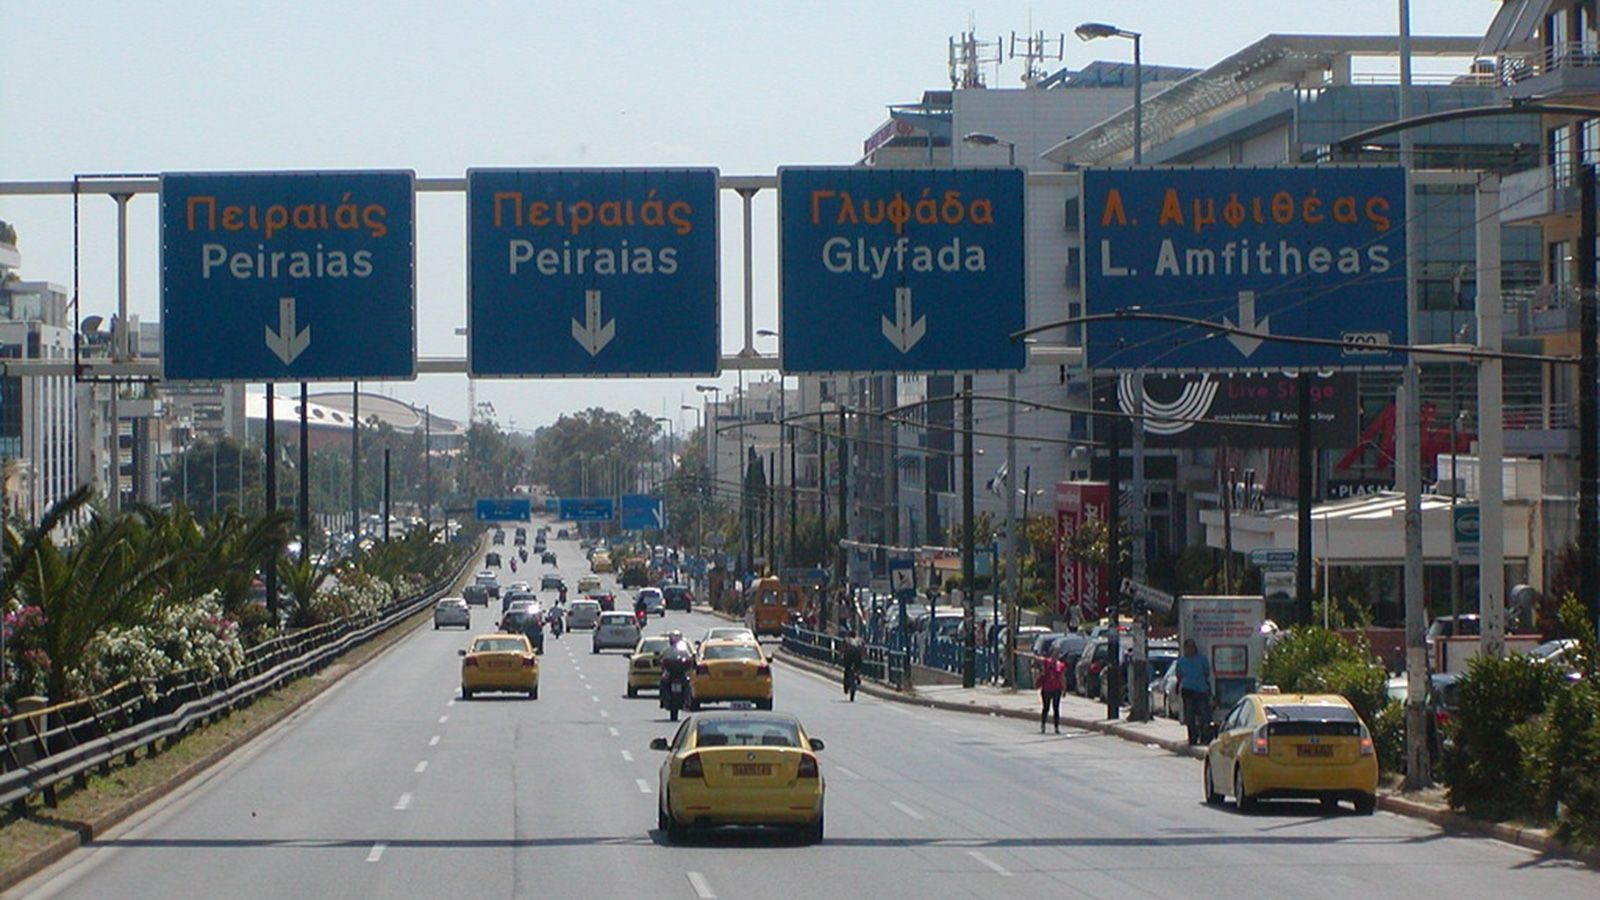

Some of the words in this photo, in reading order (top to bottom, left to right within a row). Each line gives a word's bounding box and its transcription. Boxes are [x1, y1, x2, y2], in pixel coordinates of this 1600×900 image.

[187, 192, 388, 240] Πειραιάς
[493, 189, 693, 235] Πειραιάς
[811, 188, 994, 235] Γλυφάδα
[1100, 189, 1138, 226] Λ.
[1158, 189, 1391, 234] Αμφιθέας
[202, 243, 374, 279] Peiraias
[509, 240, 678, 275] Peiraias
[822, 236, 987, 280] Glyfada
[1101, 239, 1138, 276] L.
[1154, 238, 1391, 277] Amfitheas
[1228, 381, 1269, 399] Live
[1277, 381, 1334, 402] Stge
